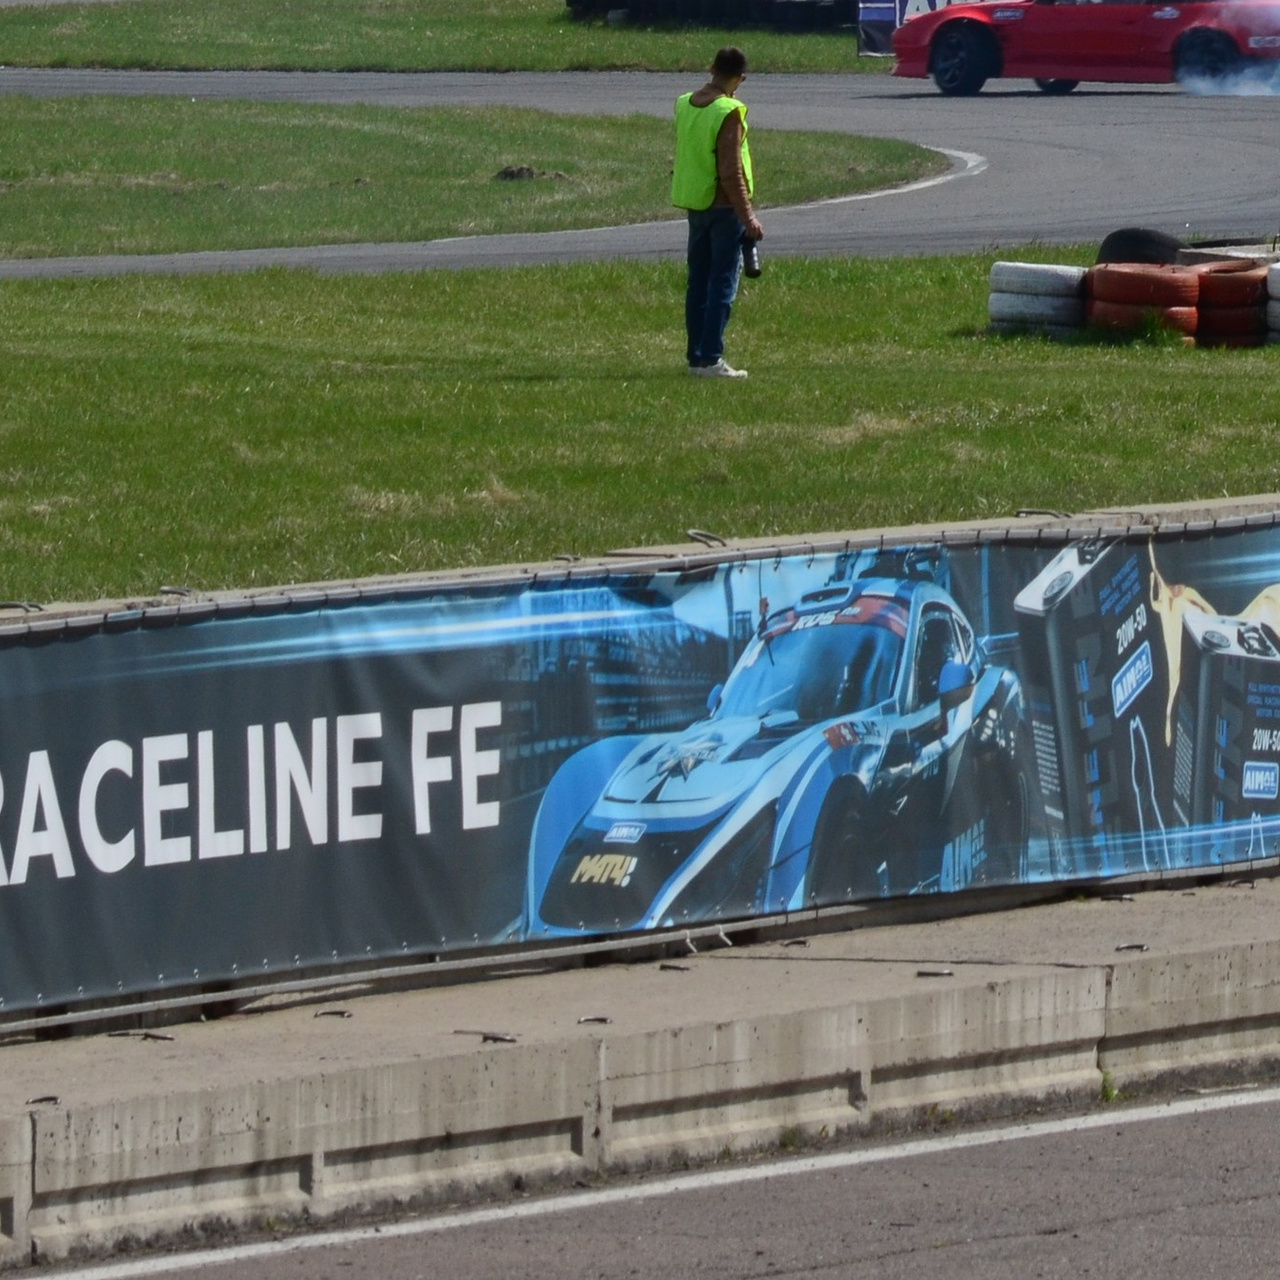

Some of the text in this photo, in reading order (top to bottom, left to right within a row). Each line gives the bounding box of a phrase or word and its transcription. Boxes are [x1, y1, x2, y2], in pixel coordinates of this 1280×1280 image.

[1115, 603, 1147, 655] 20W-50
[1114, 652, 1151, 708] AIMOL
[0, 700, 502, 886] ACELINE FE
[1244, 770, 1277, 791] AIMOL
